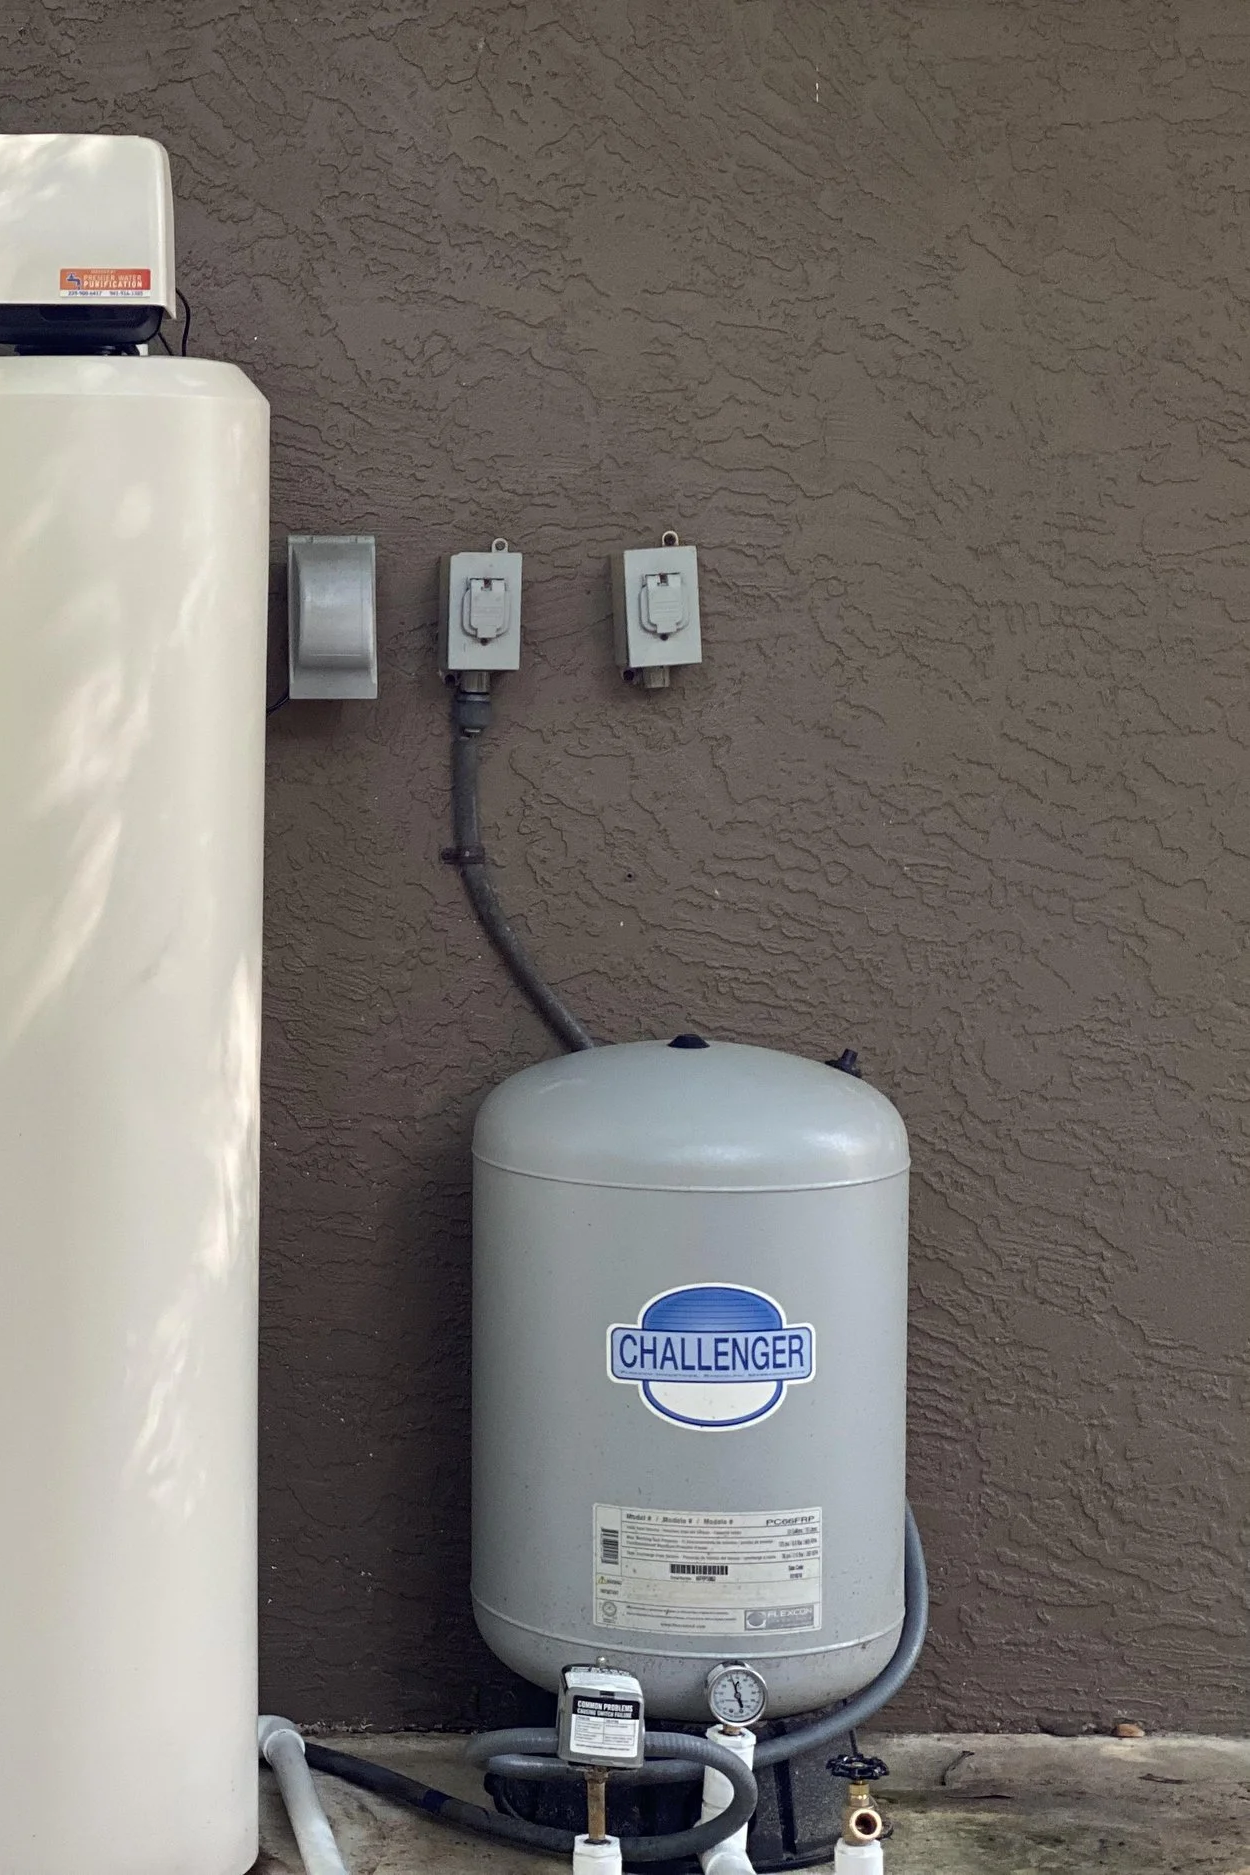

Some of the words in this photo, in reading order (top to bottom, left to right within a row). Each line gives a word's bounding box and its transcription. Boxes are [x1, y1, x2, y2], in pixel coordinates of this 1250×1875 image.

[619, 1334, 804, 1371] CHALLENGER
[767, 1608, 812, 1617] FLEXCON
[577, 1700, 603, 1710] COMMON
[603, 1703, 633, 1713] PROBLEMS
